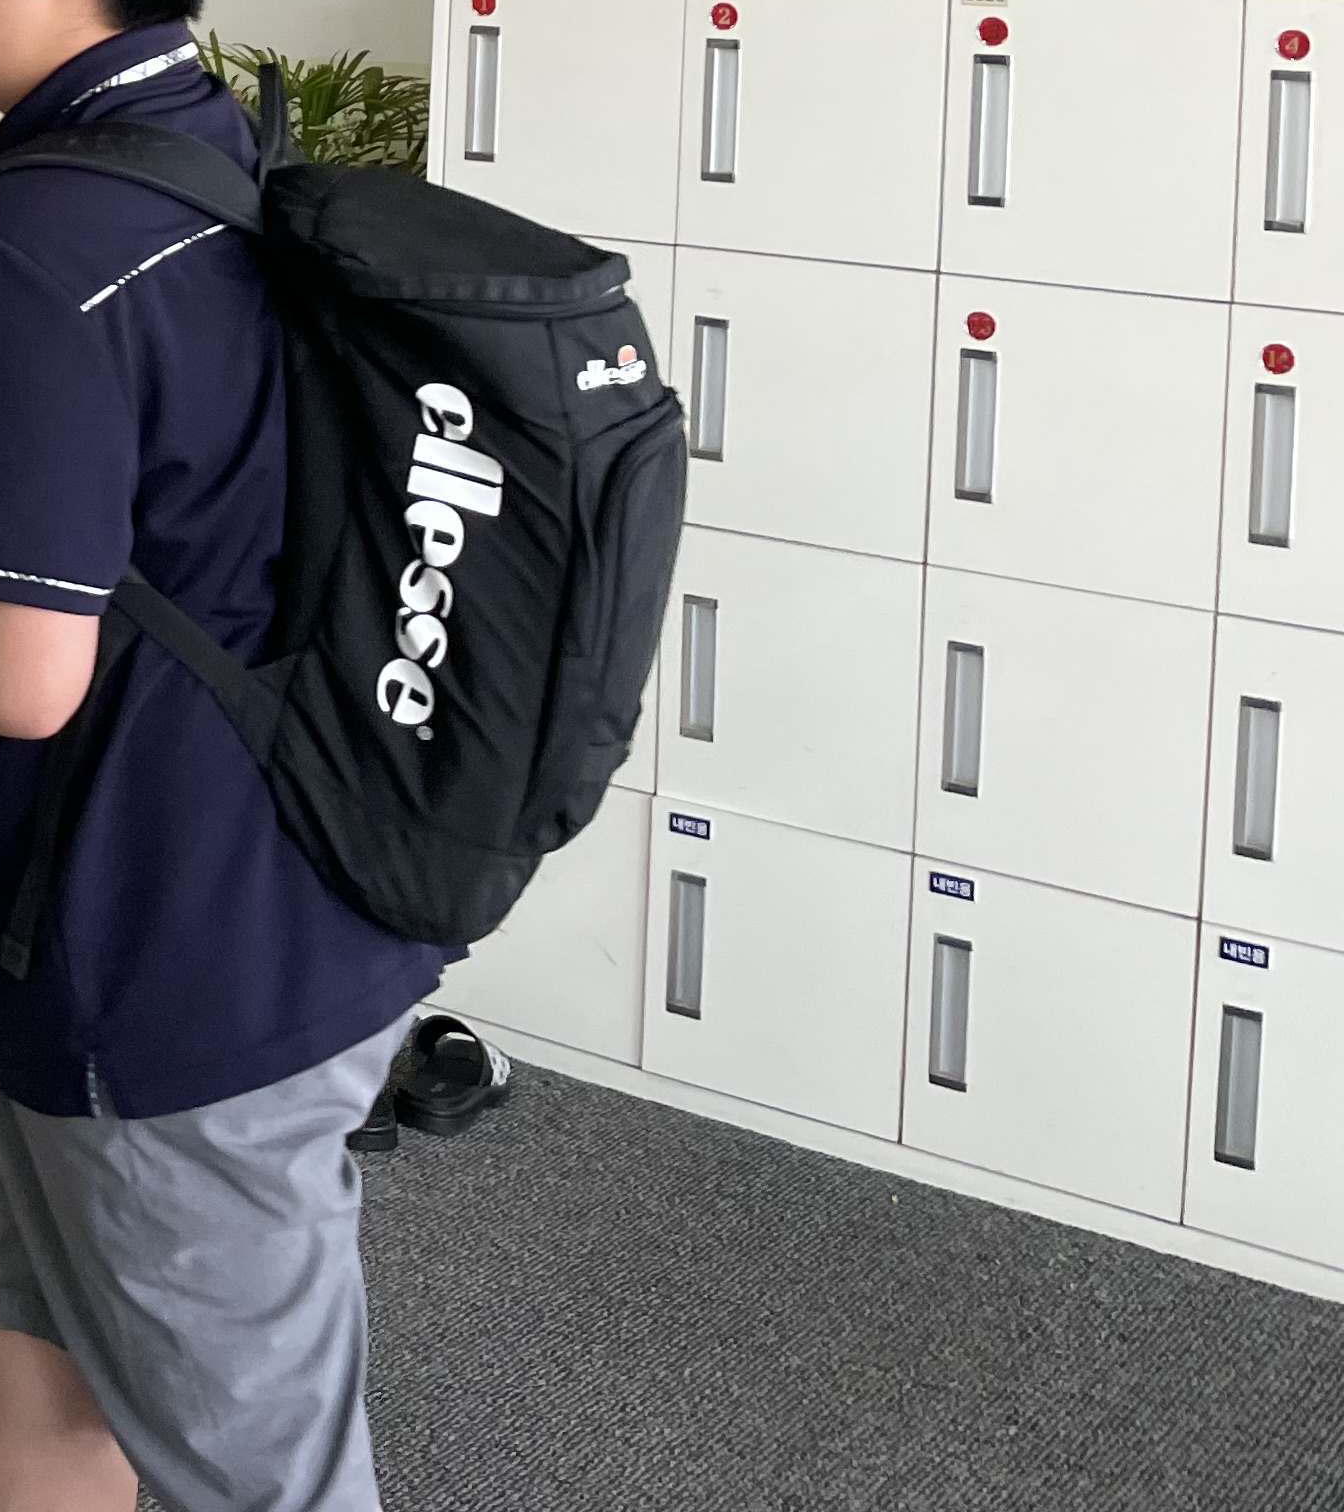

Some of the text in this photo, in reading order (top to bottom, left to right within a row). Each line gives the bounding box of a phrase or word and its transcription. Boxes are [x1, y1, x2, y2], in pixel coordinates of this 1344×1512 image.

[719, 9, 731, 25] 2
[1285, 37, 1299, 54] 4
[377, 382, 504, 725] ellesse
